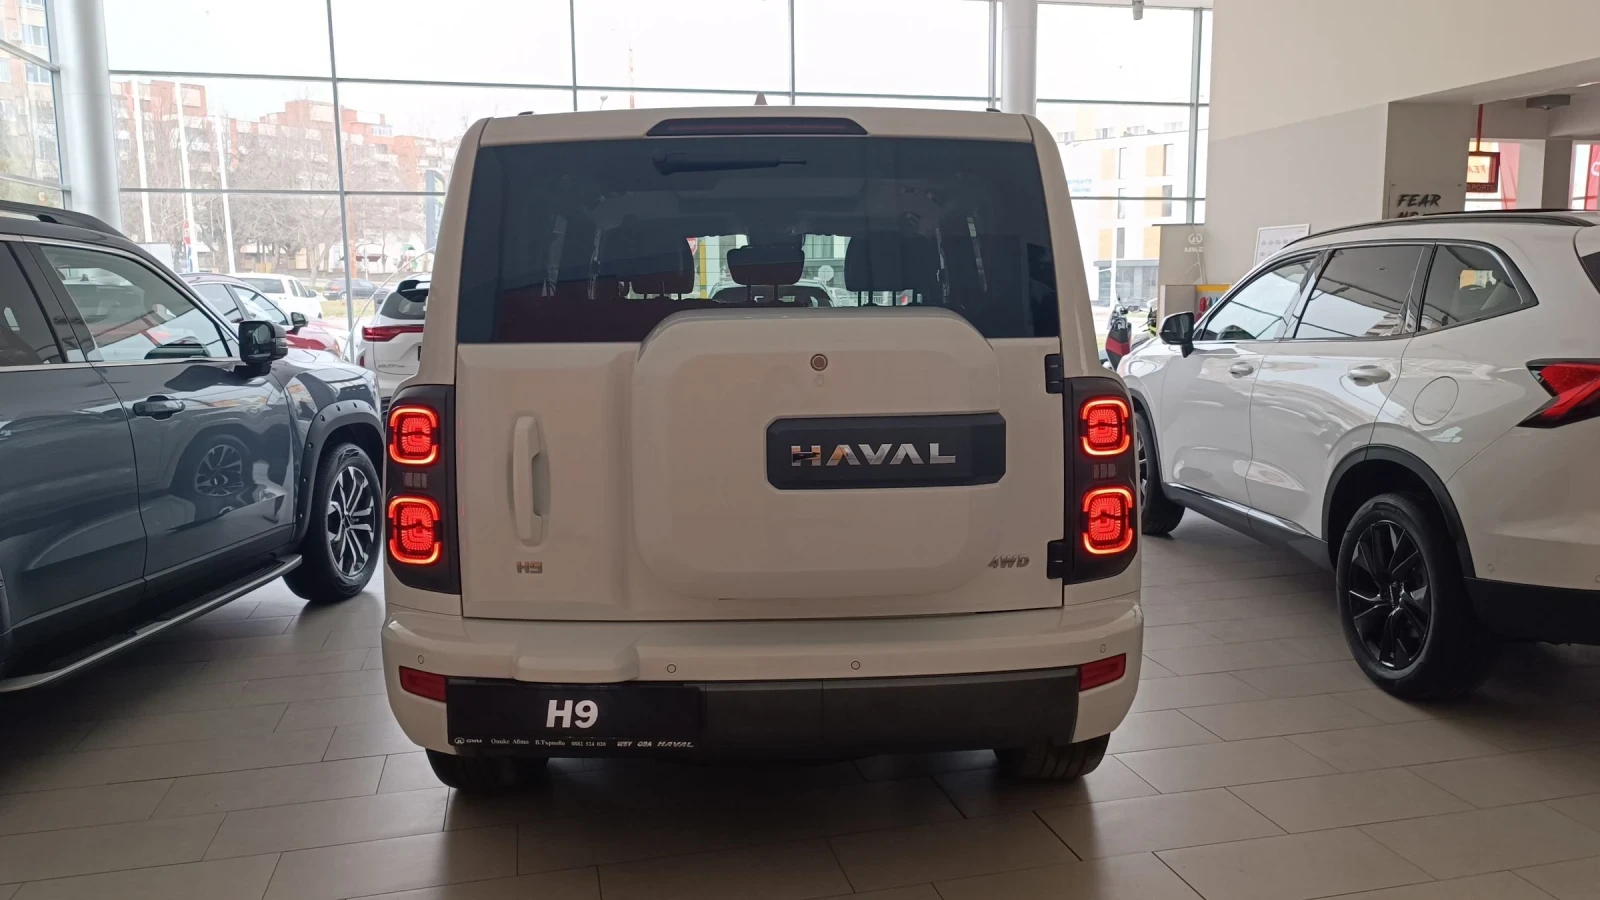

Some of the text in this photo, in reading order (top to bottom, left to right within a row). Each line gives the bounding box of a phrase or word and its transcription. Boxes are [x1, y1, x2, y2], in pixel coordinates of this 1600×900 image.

[1397, 194, 1442, 207] FEAR
[791, 443, 956, 466] HAVAL
[516, 561, 543, 574] H9
[988, 554, 1029, 568] 4WD
[546, 699, 599, 729] H9
